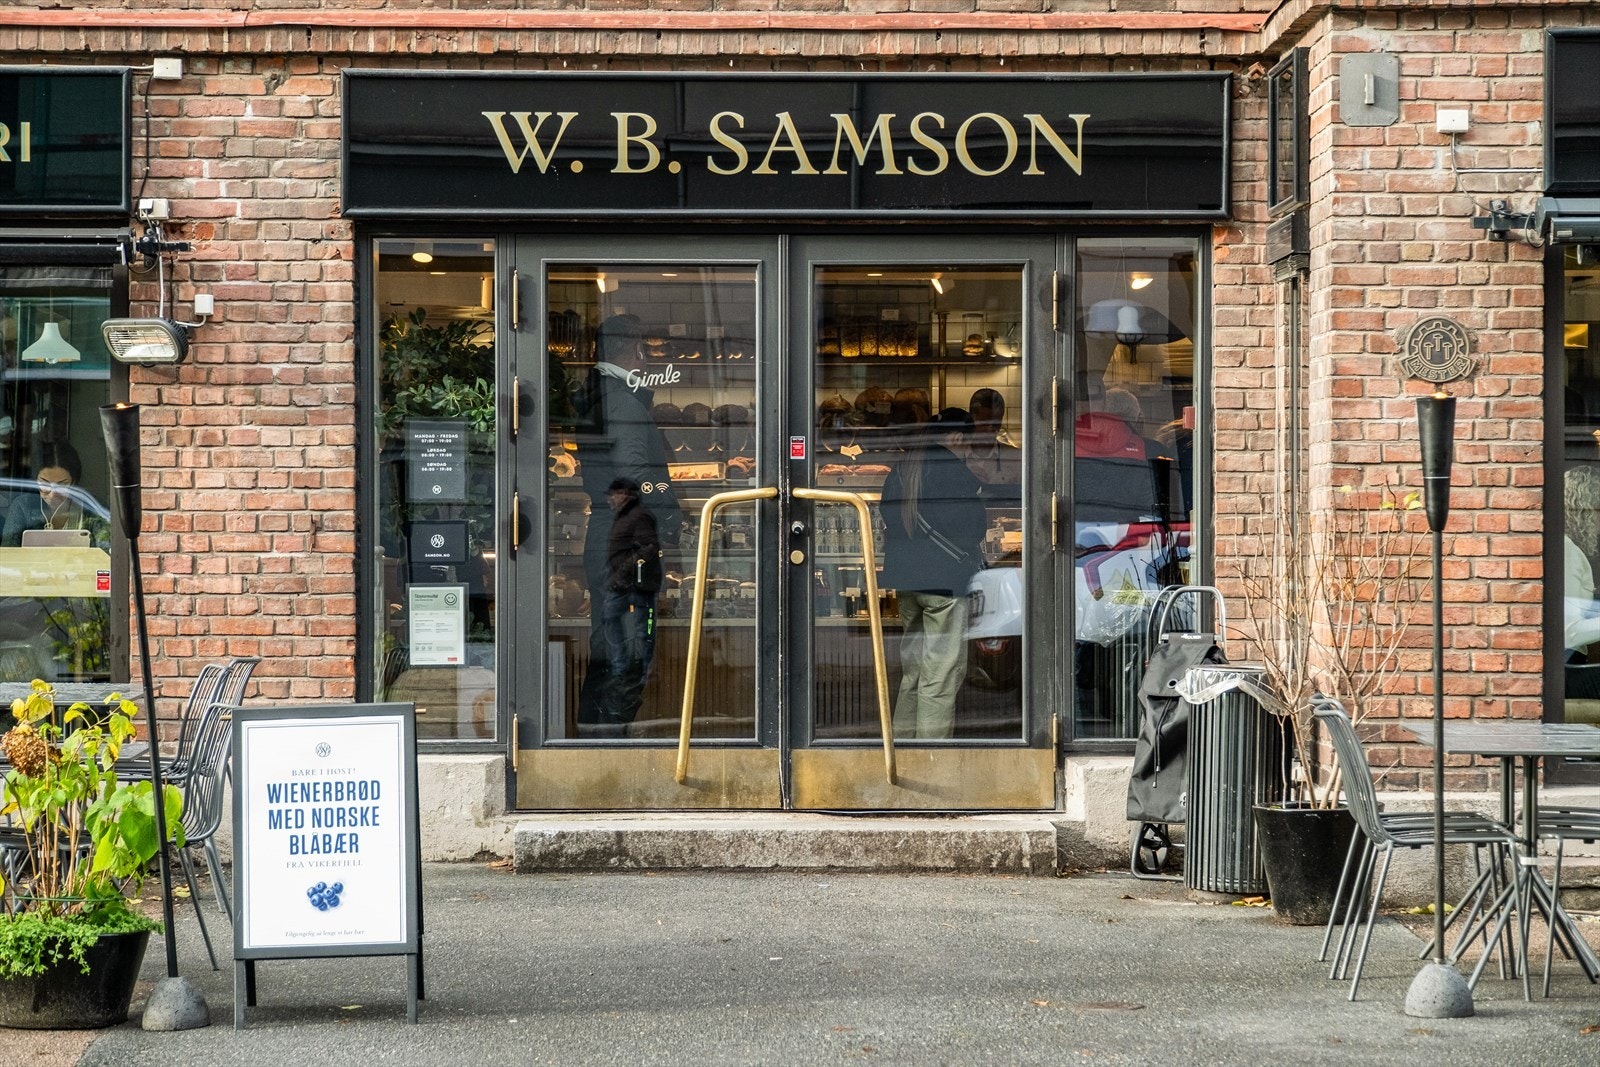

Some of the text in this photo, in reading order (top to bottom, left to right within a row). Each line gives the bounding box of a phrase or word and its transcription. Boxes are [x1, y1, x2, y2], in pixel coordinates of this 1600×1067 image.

[481, 111, 1091, 176] W. B. SAMSON
[626, 363, 681, 393] Gimle
[1410, 358, 1466, 380] MESTER
[291, 768, 317, 777] BARE
[266, 779, 381, 804] WIENERBRØD
[268, 806, 380, 830] MED NORSKE
[289, 831, 359, 856] BLÅBÆR
[286, 861, 305, 869] FRA
